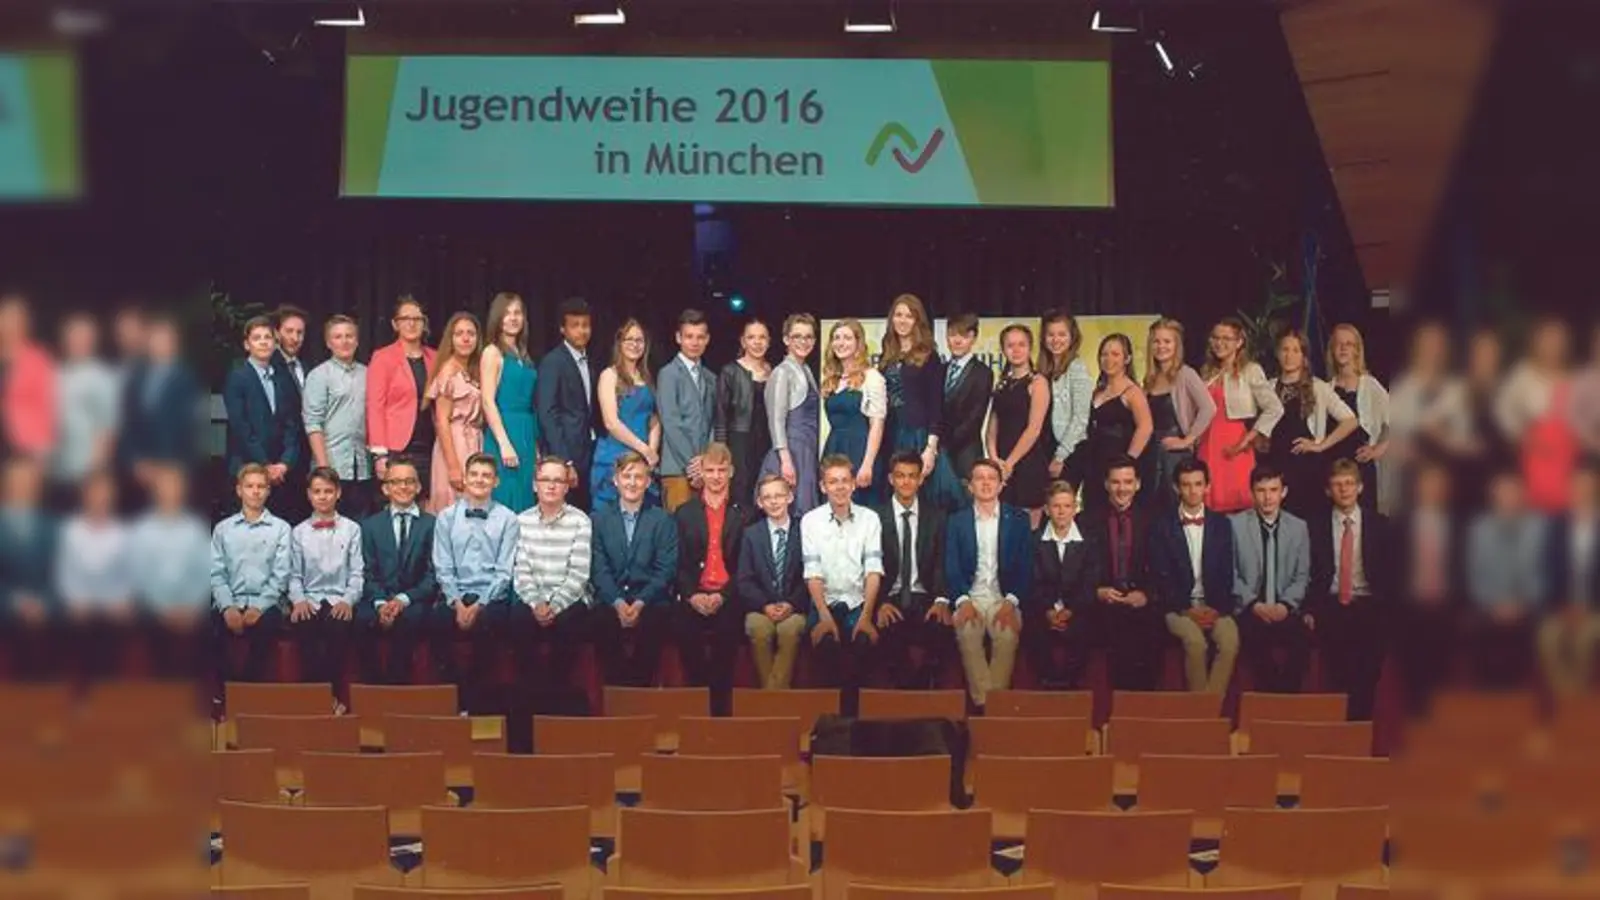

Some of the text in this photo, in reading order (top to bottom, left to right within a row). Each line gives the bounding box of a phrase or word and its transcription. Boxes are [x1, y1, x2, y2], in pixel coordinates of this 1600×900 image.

[405, 85, 825, 131] Jugendweihe 2016
[593, 141, 824, 177] in München
